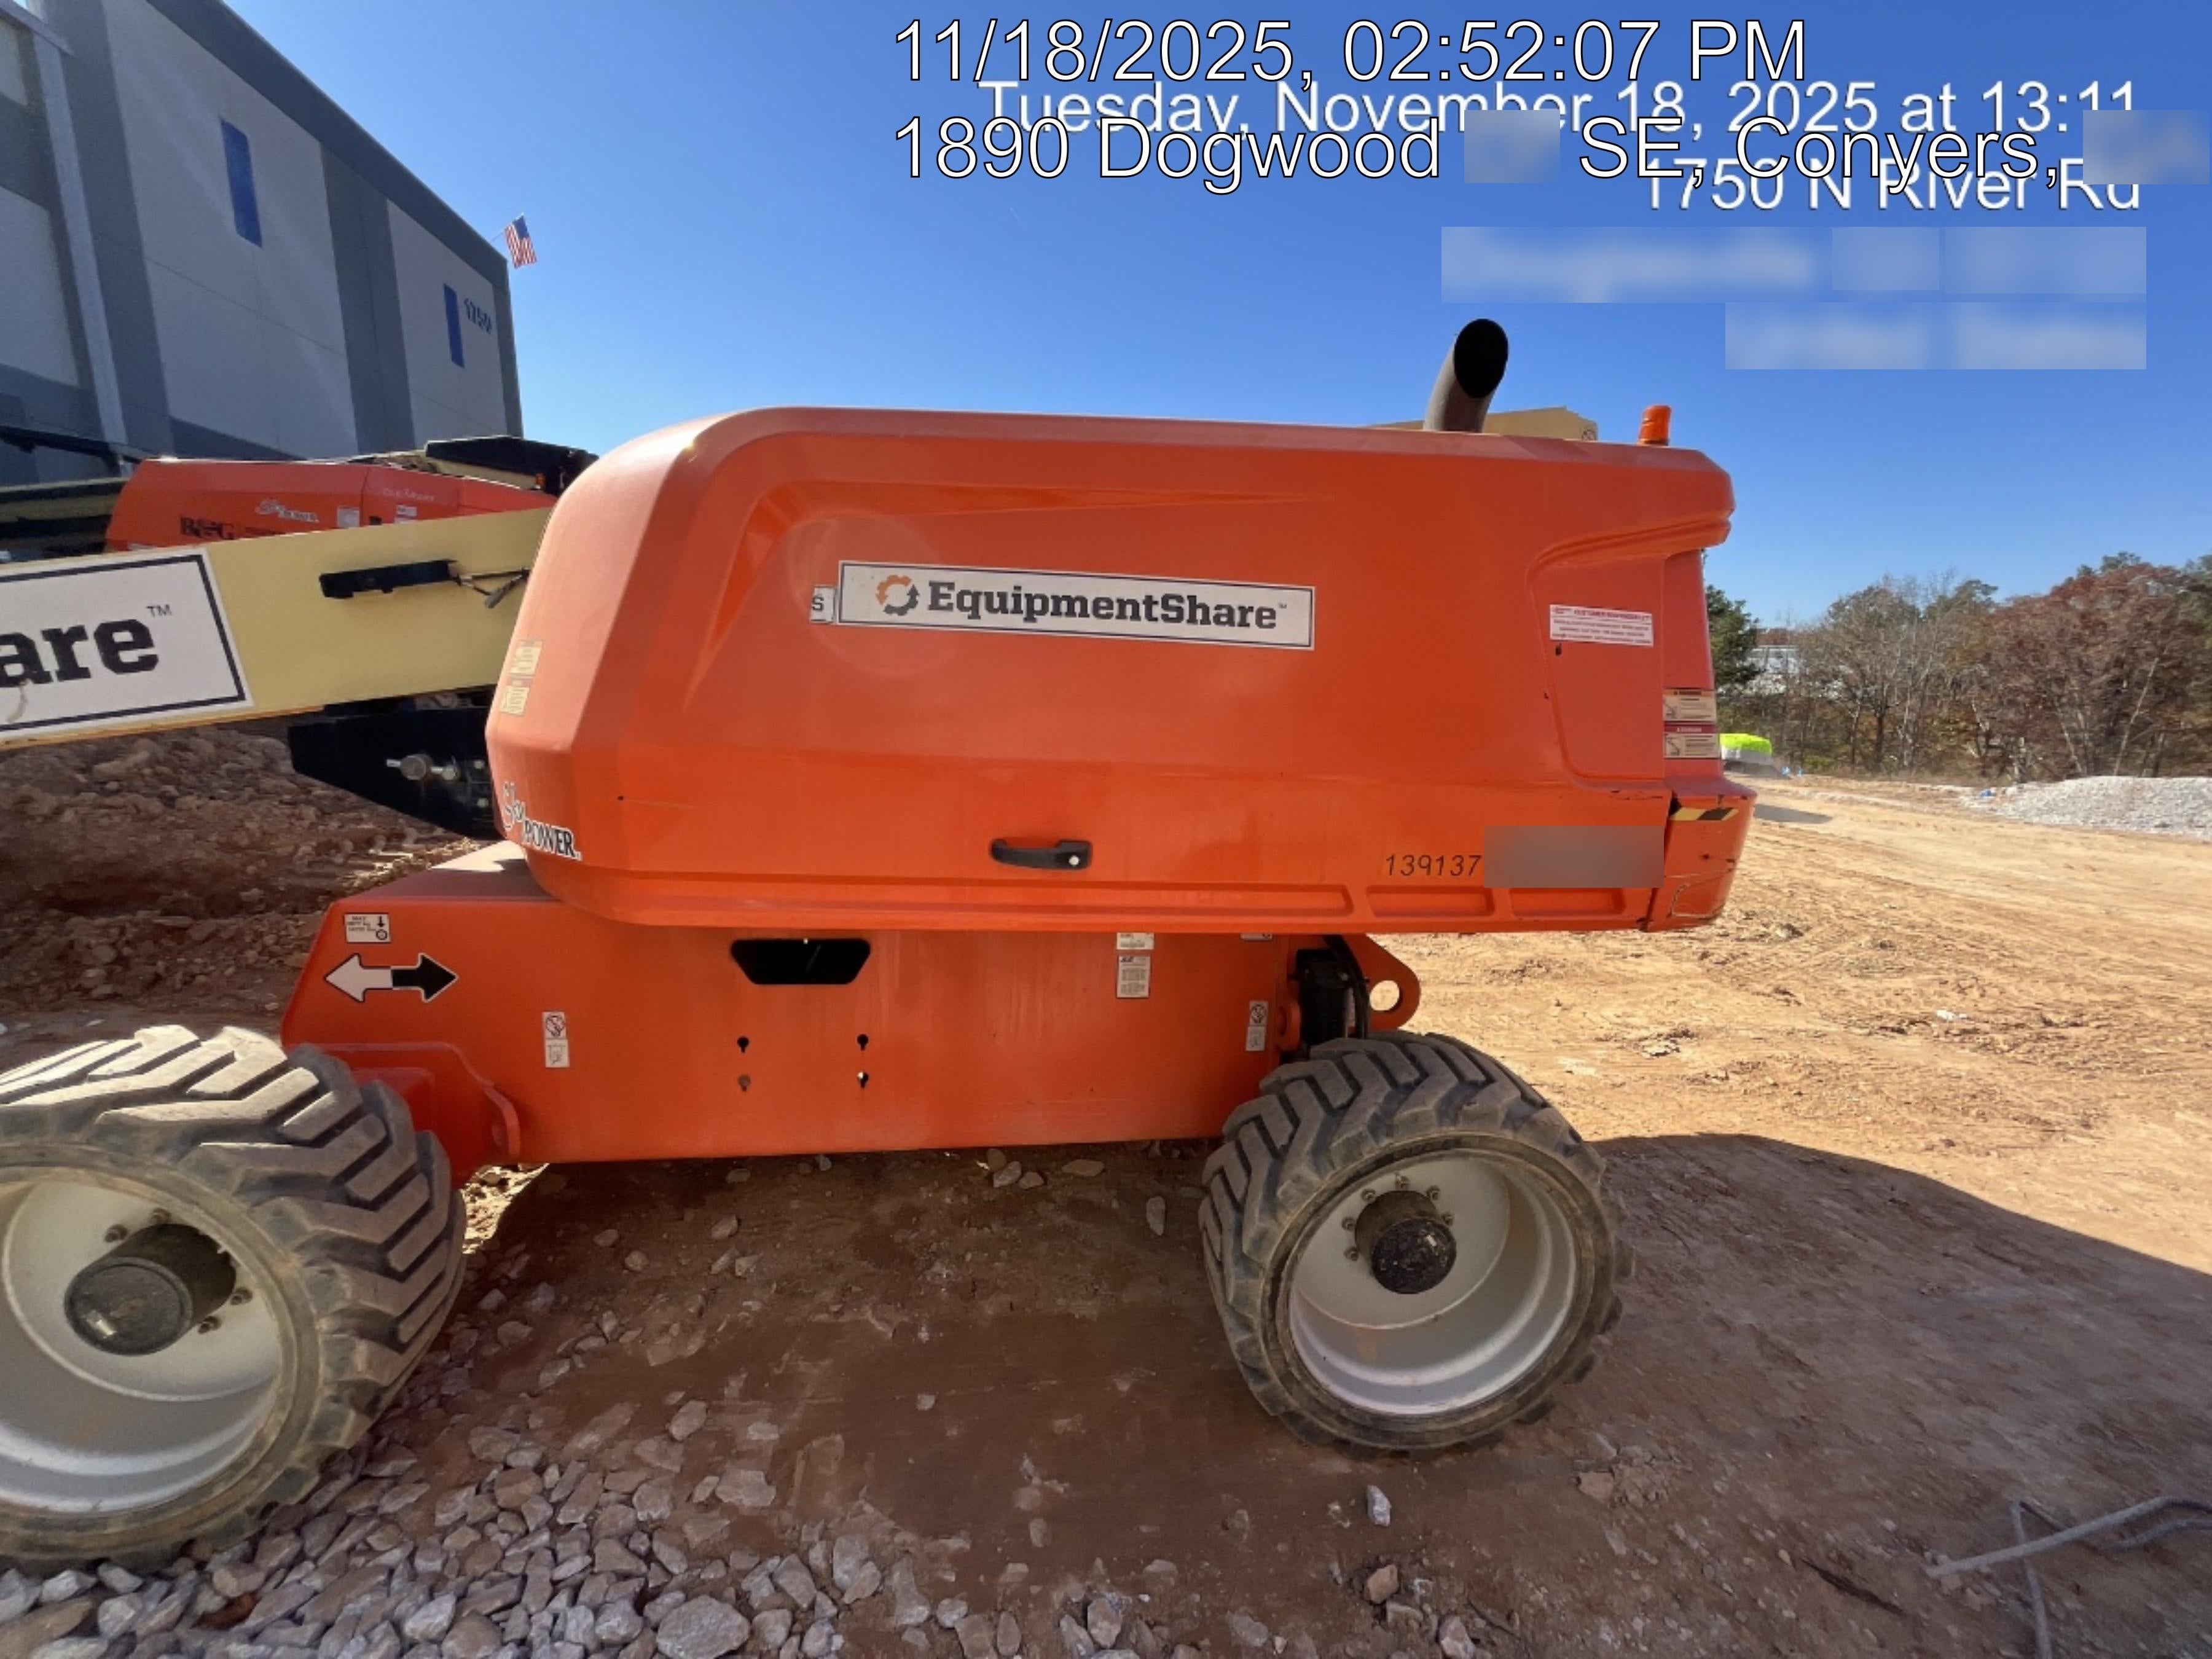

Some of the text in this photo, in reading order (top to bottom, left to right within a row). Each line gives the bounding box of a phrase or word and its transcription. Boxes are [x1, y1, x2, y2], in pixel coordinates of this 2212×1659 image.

[146, 603, 172, 617] TM
[928, 580, 1277, 629] EquipmentShare
[0, 619, 159, 688] are
[524, 819, 578, 858] POWER
[1386, 854, 1483, 877] 139137
